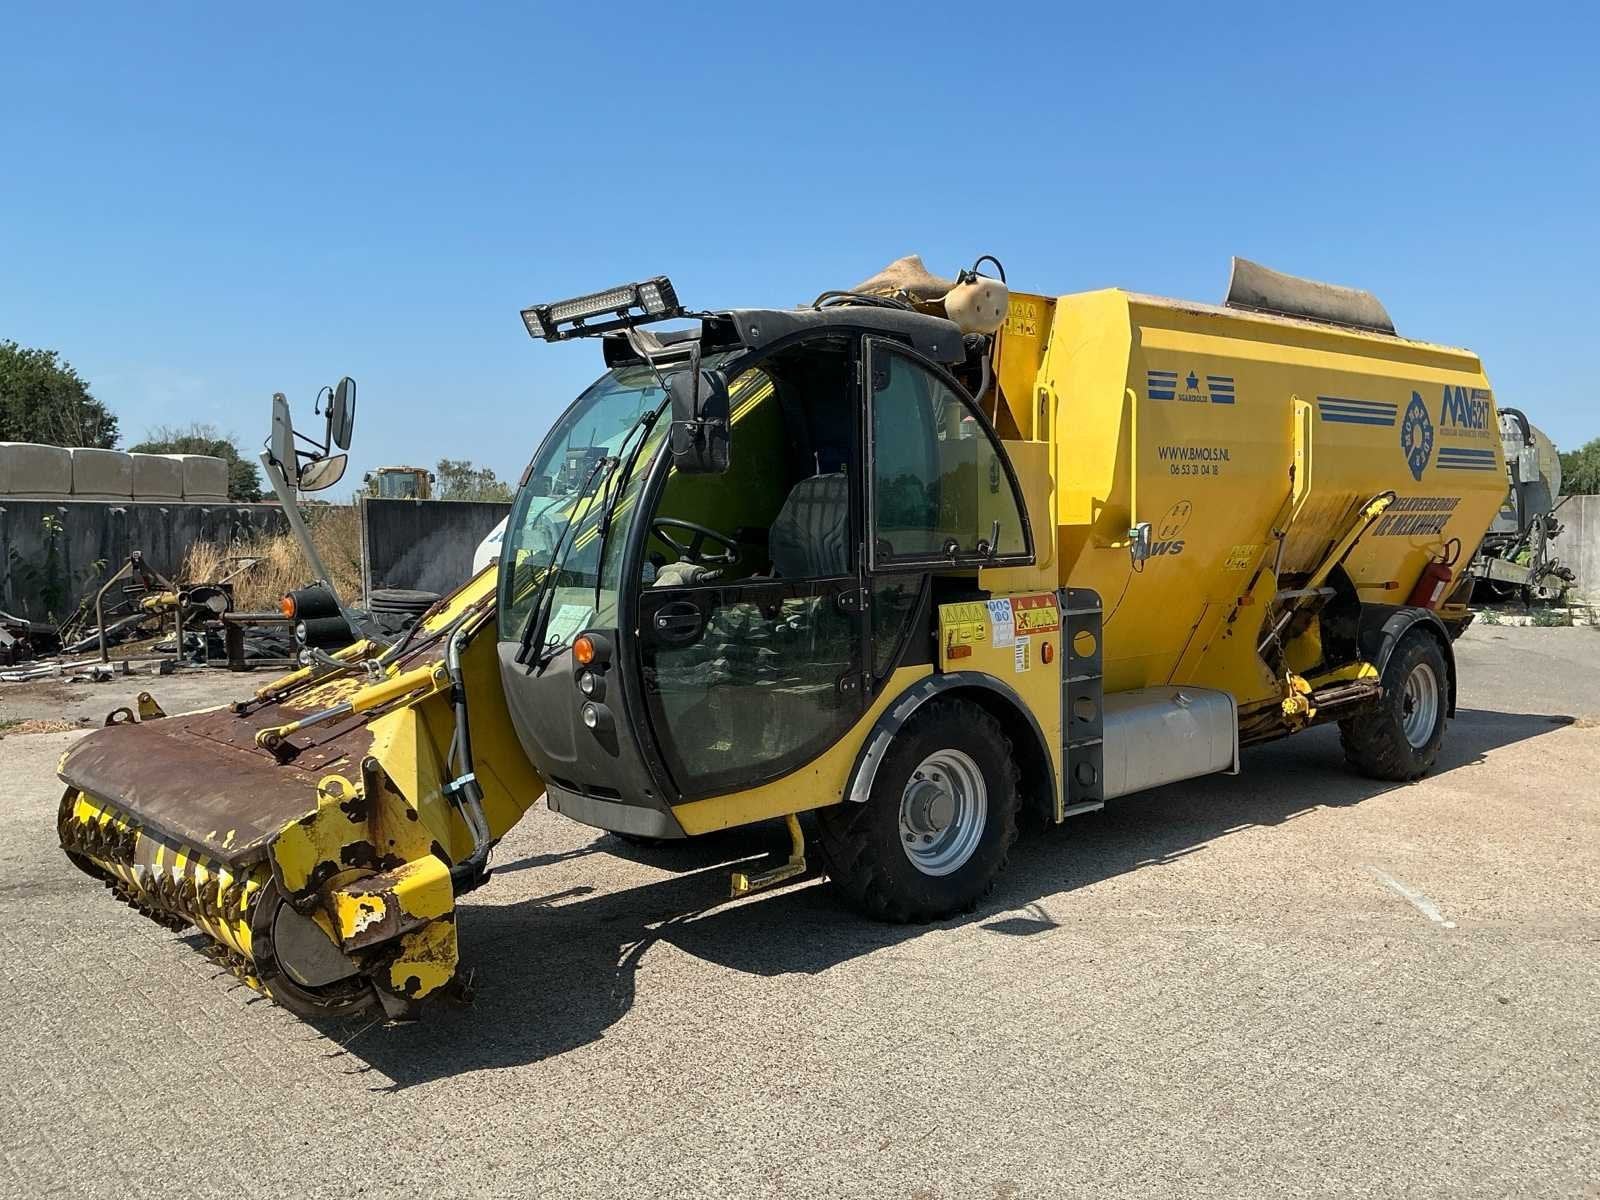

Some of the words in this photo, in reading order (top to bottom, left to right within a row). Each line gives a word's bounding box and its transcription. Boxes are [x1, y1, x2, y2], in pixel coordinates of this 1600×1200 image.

[1158, 446, 1230, 461] WWW.BMOLS.NL
[1170, 463, 1179, 475] 06
[1181, 464, 1190, 475] 53
[1372, 514, 1397, 536] DE
